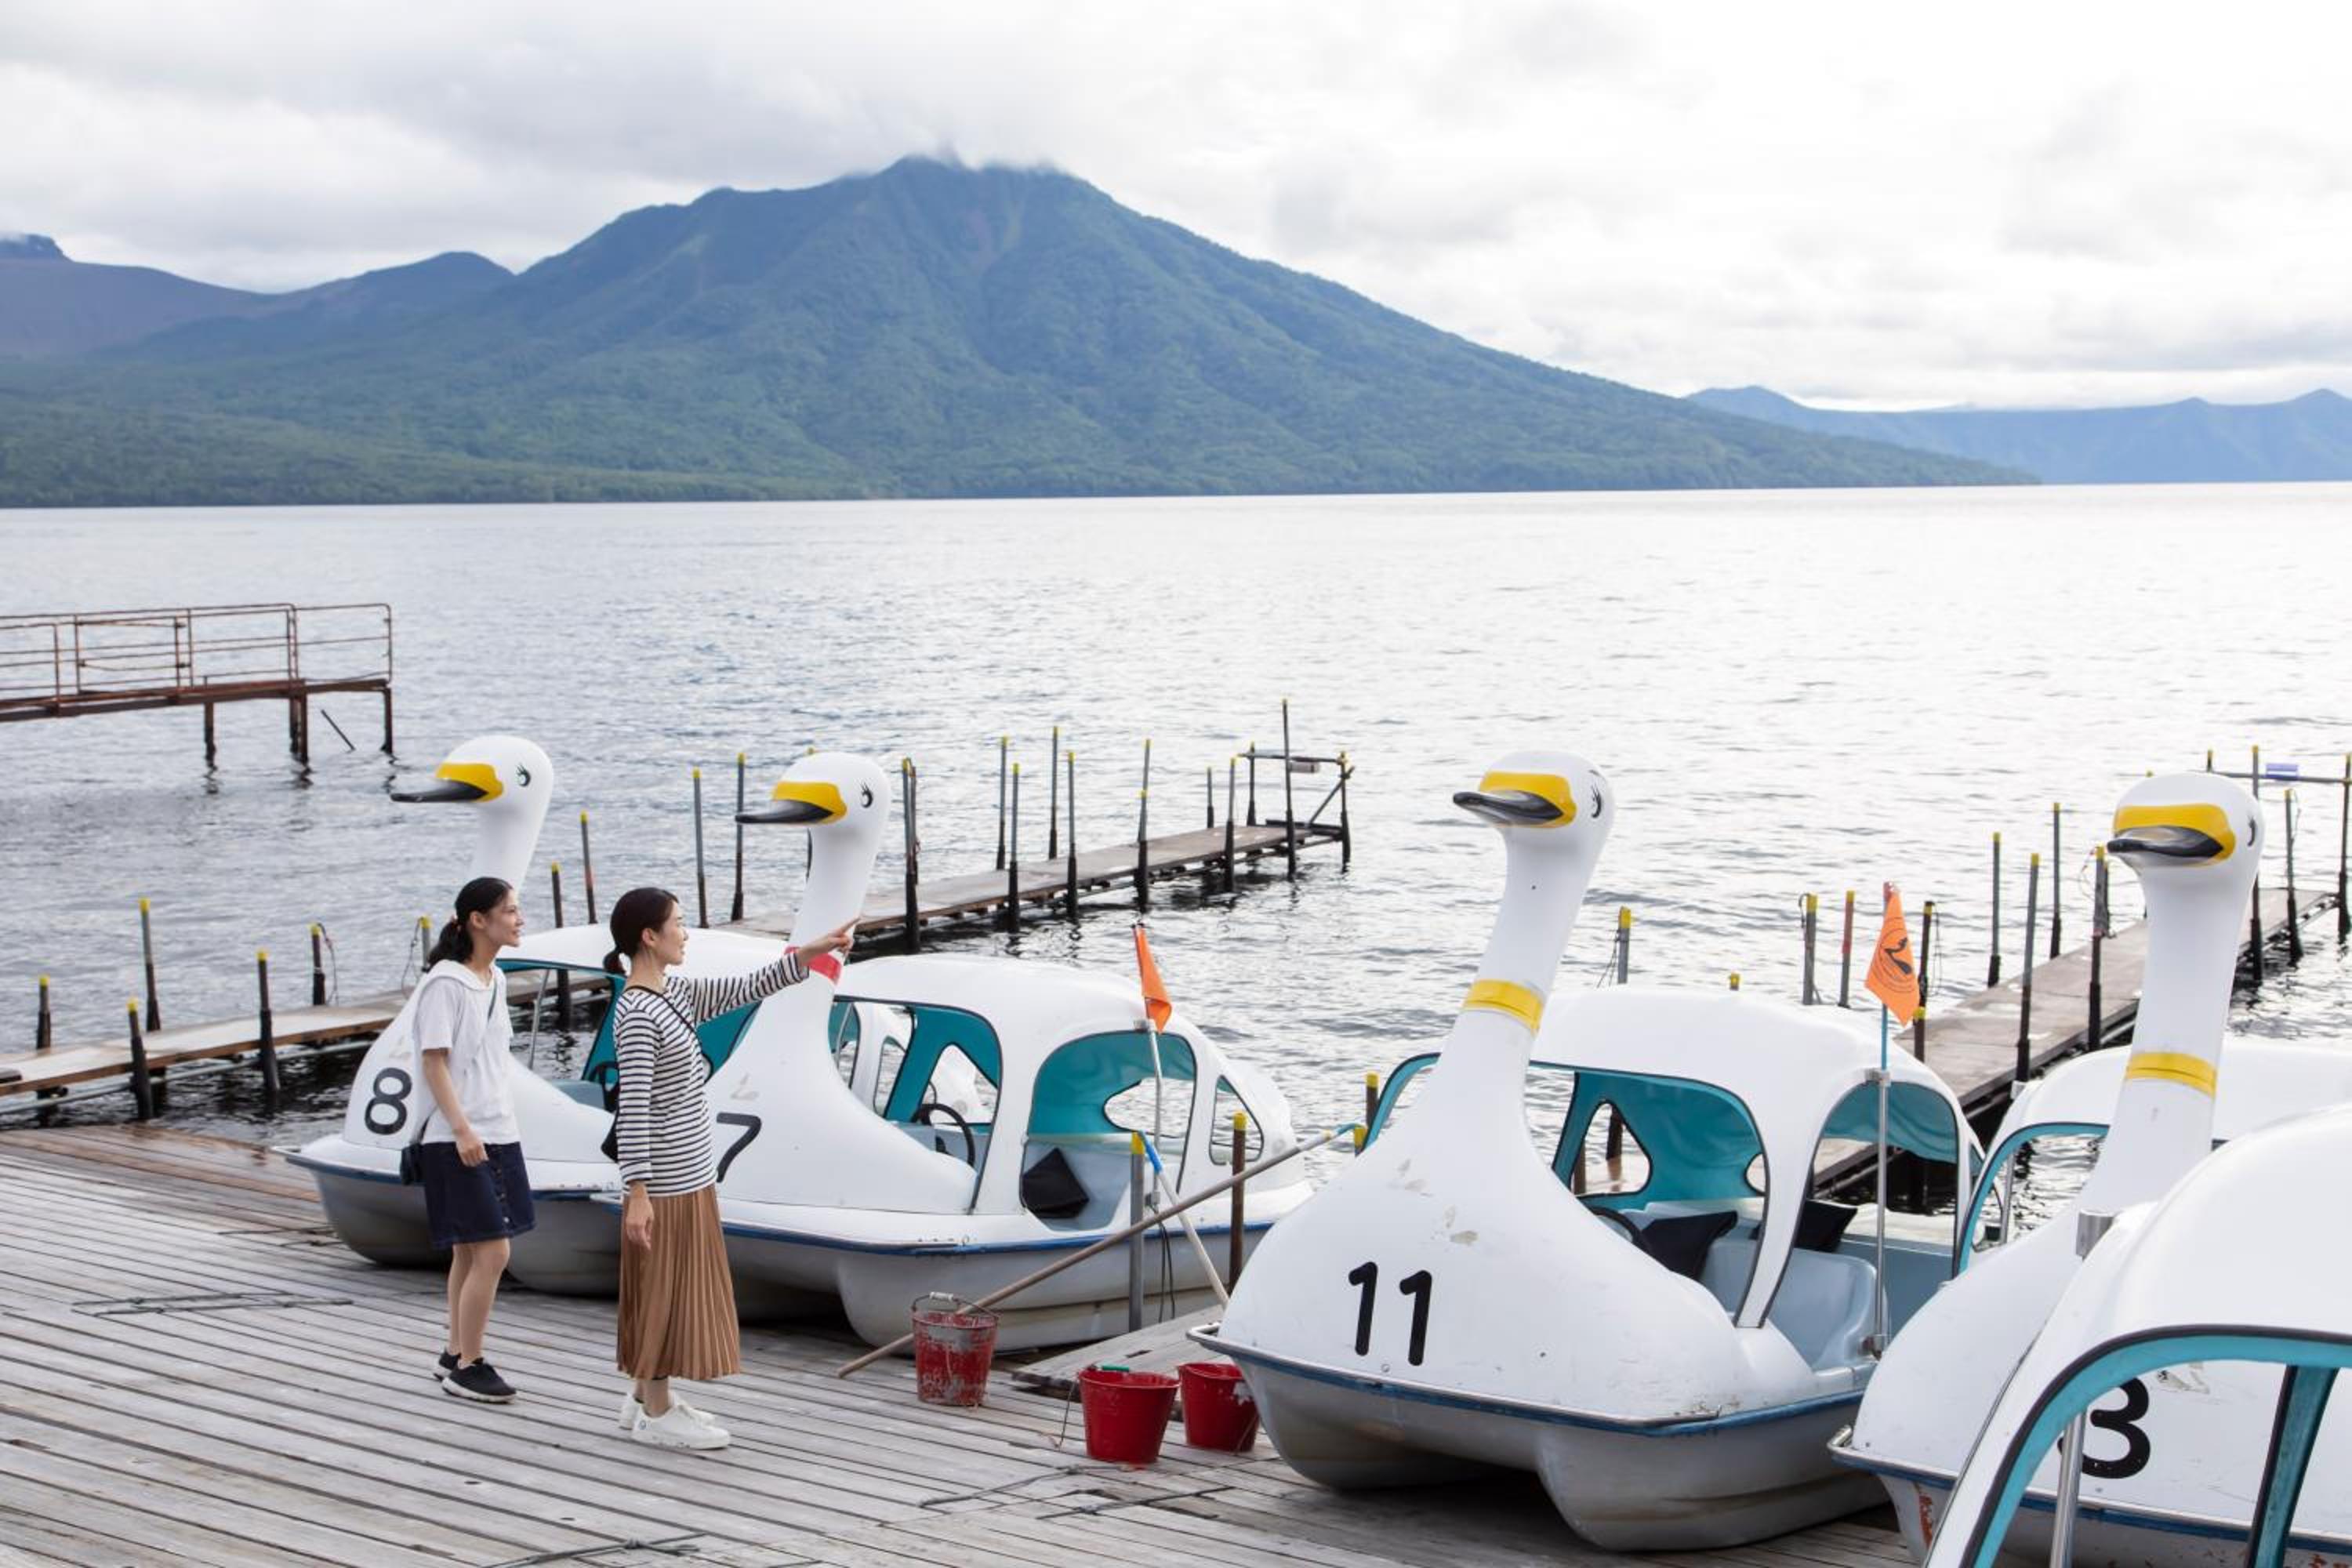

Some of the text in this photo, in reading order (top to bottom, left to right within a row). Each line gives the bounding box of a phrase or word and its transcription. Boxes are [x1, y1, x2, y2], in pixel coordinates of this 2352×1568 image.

[364, 1067, 412, 1135] 8
[717, 1112, 762, 1183] 7
[1348, 1261, 1432, 1367] 11
